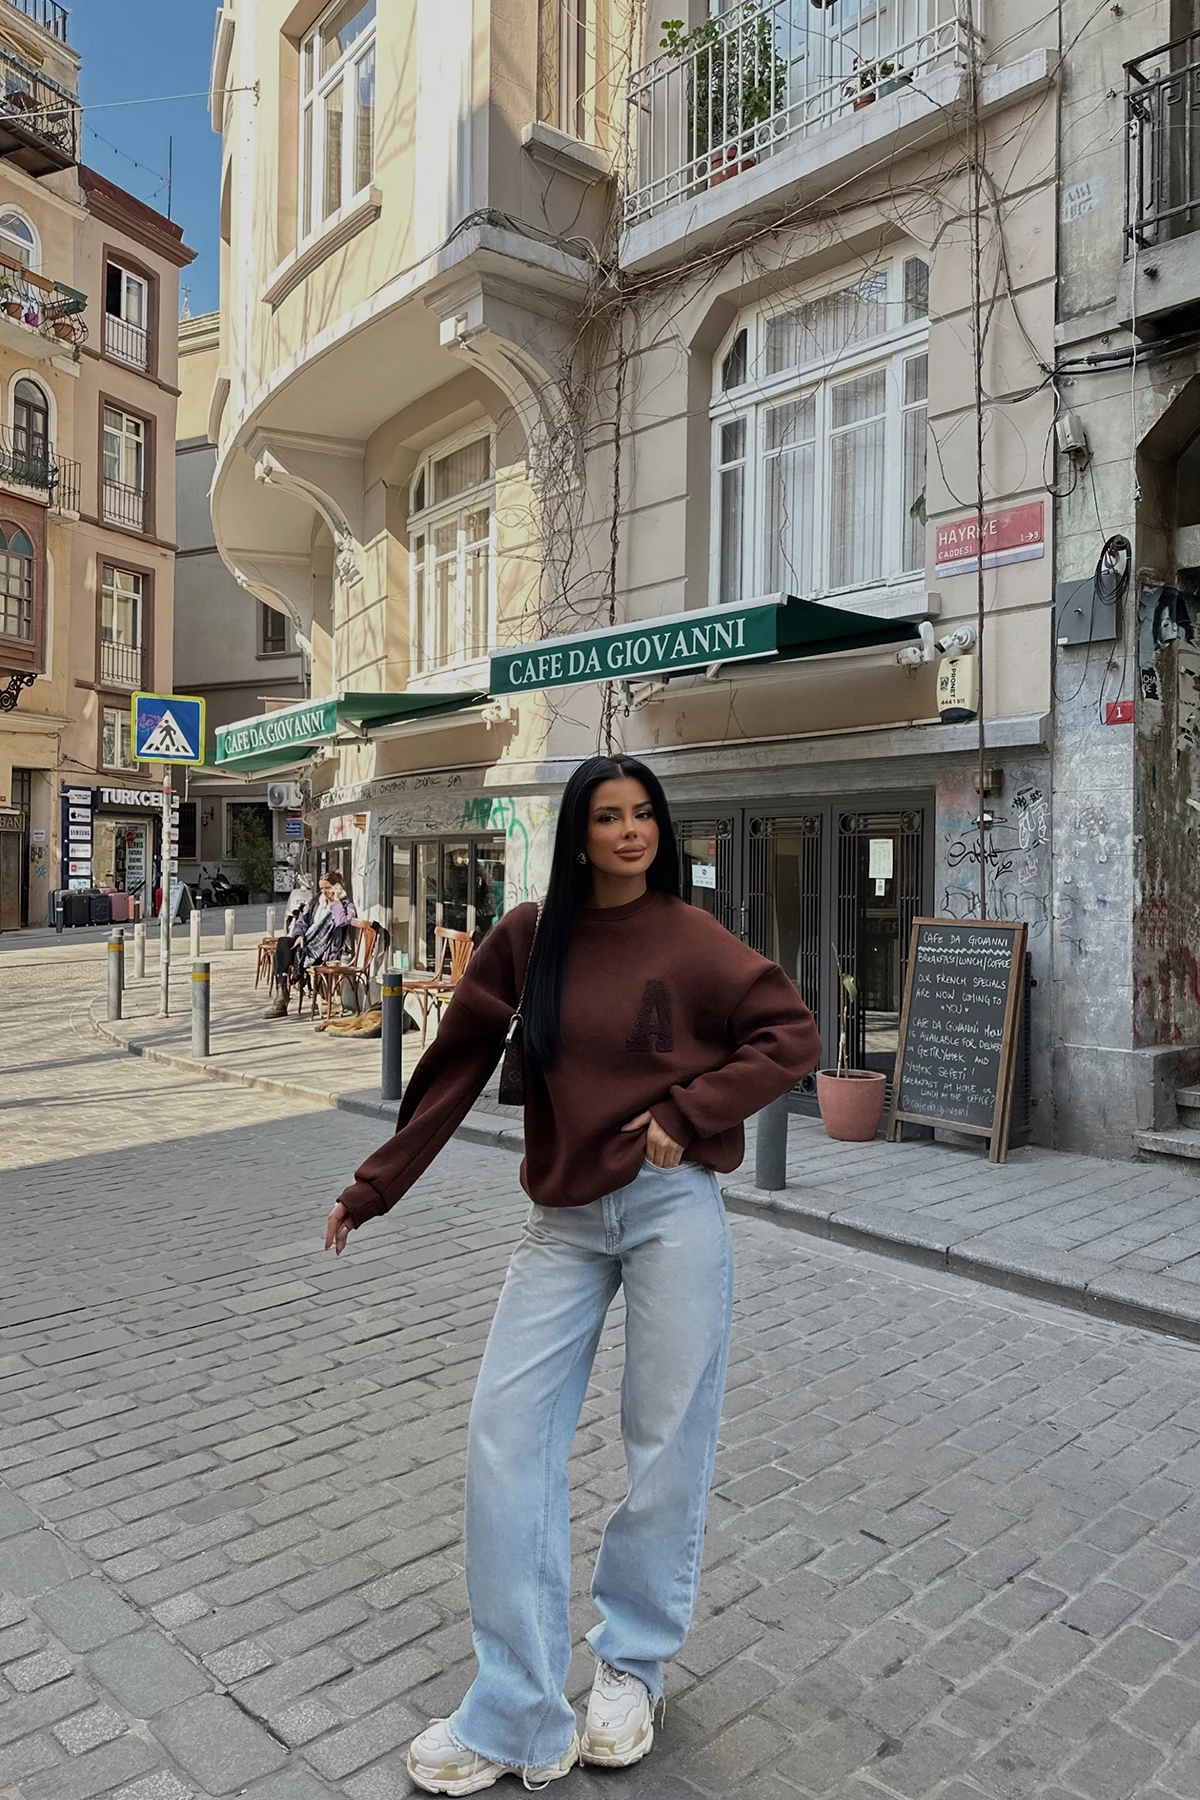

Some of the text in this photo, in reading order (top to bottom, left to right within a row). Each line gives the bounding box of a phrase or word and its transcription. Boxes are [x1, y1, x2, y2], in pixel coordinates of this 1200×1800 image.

[509, 618, 746, 685] CAFE DA GIOVANNI
[1116, 707, 1122, 718] 1
[224, 710, 325, 754] CAFE DA GIOVANNI
[100, 788, 172, 807] TURKCEL
[924, 932, 1008, 947] CAFE DA GIOVANNI
[919, 974, 1006, 989] OUR FRENCH SPECIALS
[916, 988, 1001, 1006] ARE NOW COMING TO
[626, 980, 674, 1052] A
[946, 1004, 962, 1014] YOU
[912, 1017, 929, 1028] CAFE
[932, 1020, 941, 1031] DA
[920, 1032, 959, 1046] AVAILABLE
[962, 1038, 977, 1049] FOR
[975, 1056, 989, 1065] AND
[903, 1076, 938, 1088] BREAKFAST
[957, 1084, 976, 1093] HOME
[950, 1093, 961, 1101] THE
